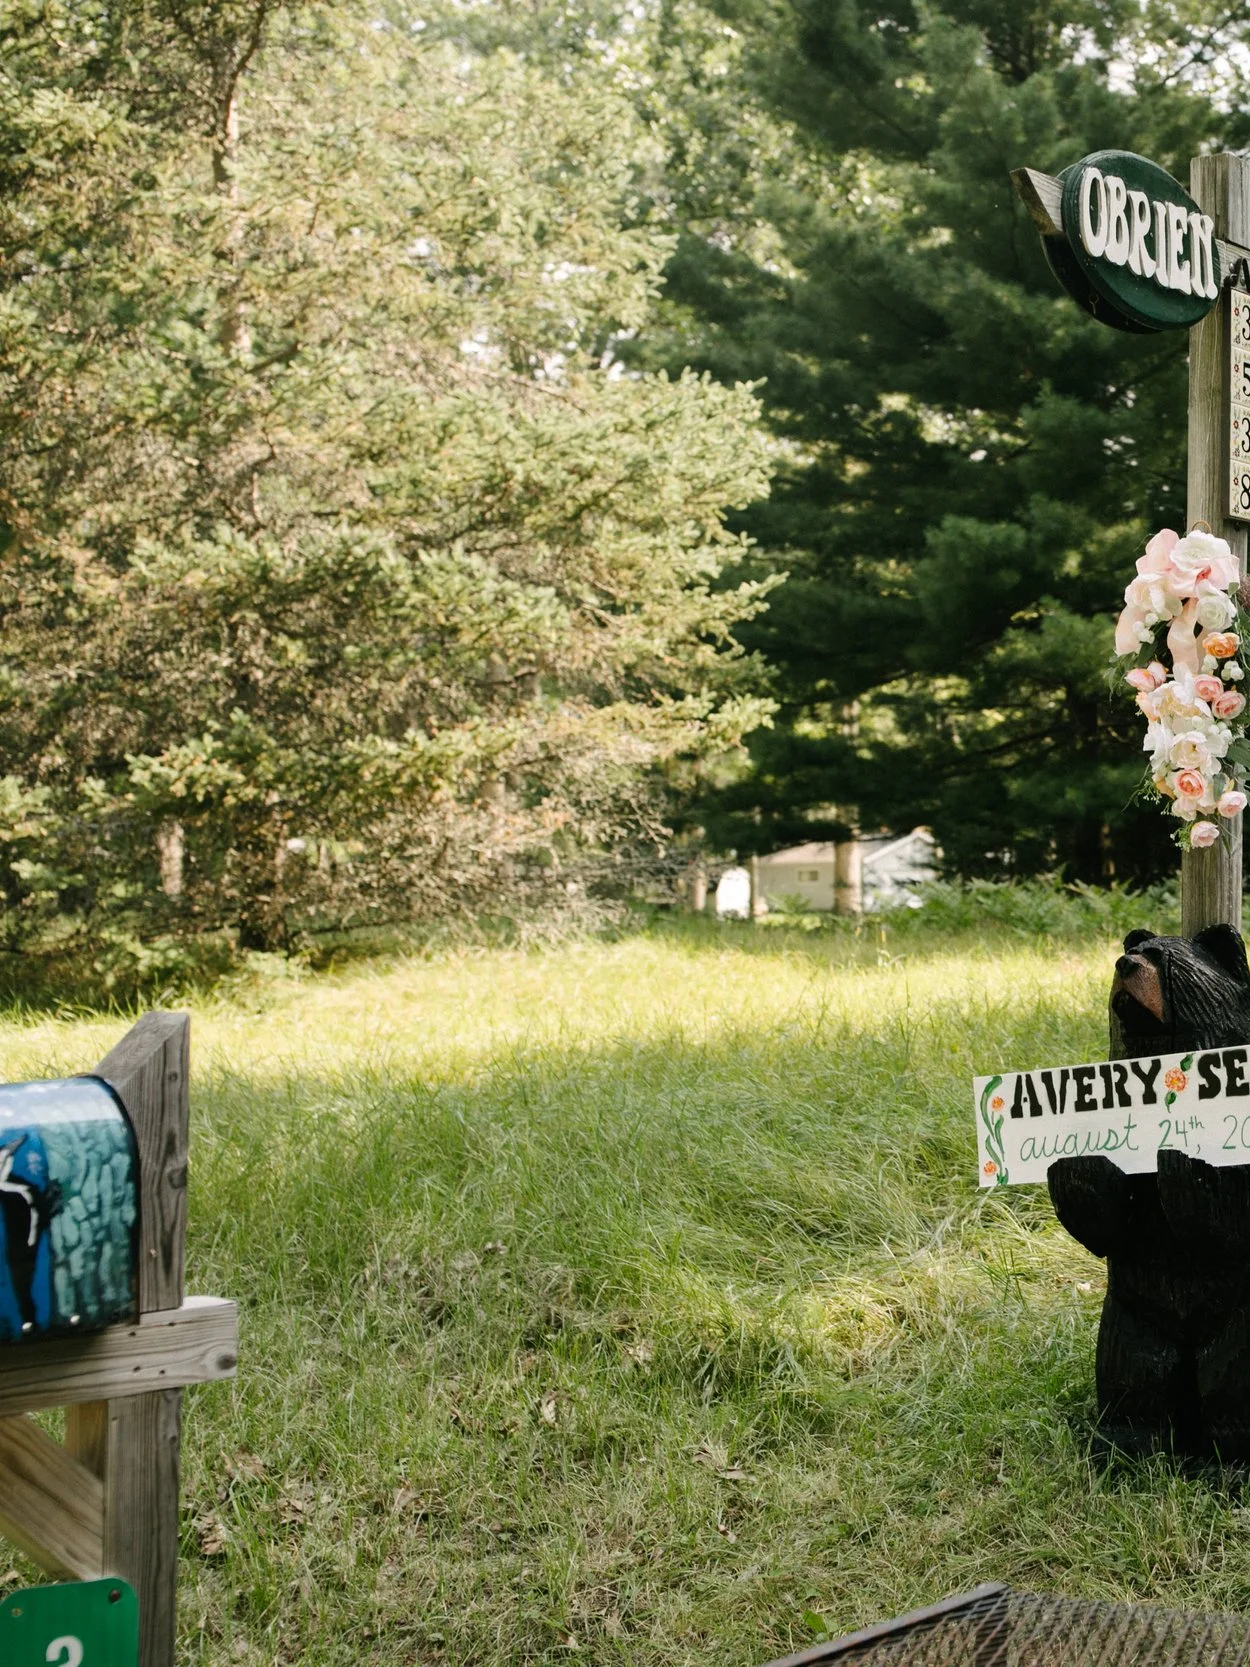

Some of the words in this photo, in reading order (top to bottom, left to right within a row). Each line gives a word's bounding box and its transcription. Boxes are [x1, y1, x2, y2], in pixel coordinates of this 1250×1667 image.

[1080, 166, 1219, 300] OBRIEN
[1011, 1059, 1162, 1118] AVERY
[1020, 1113, 1139, 1161] august
